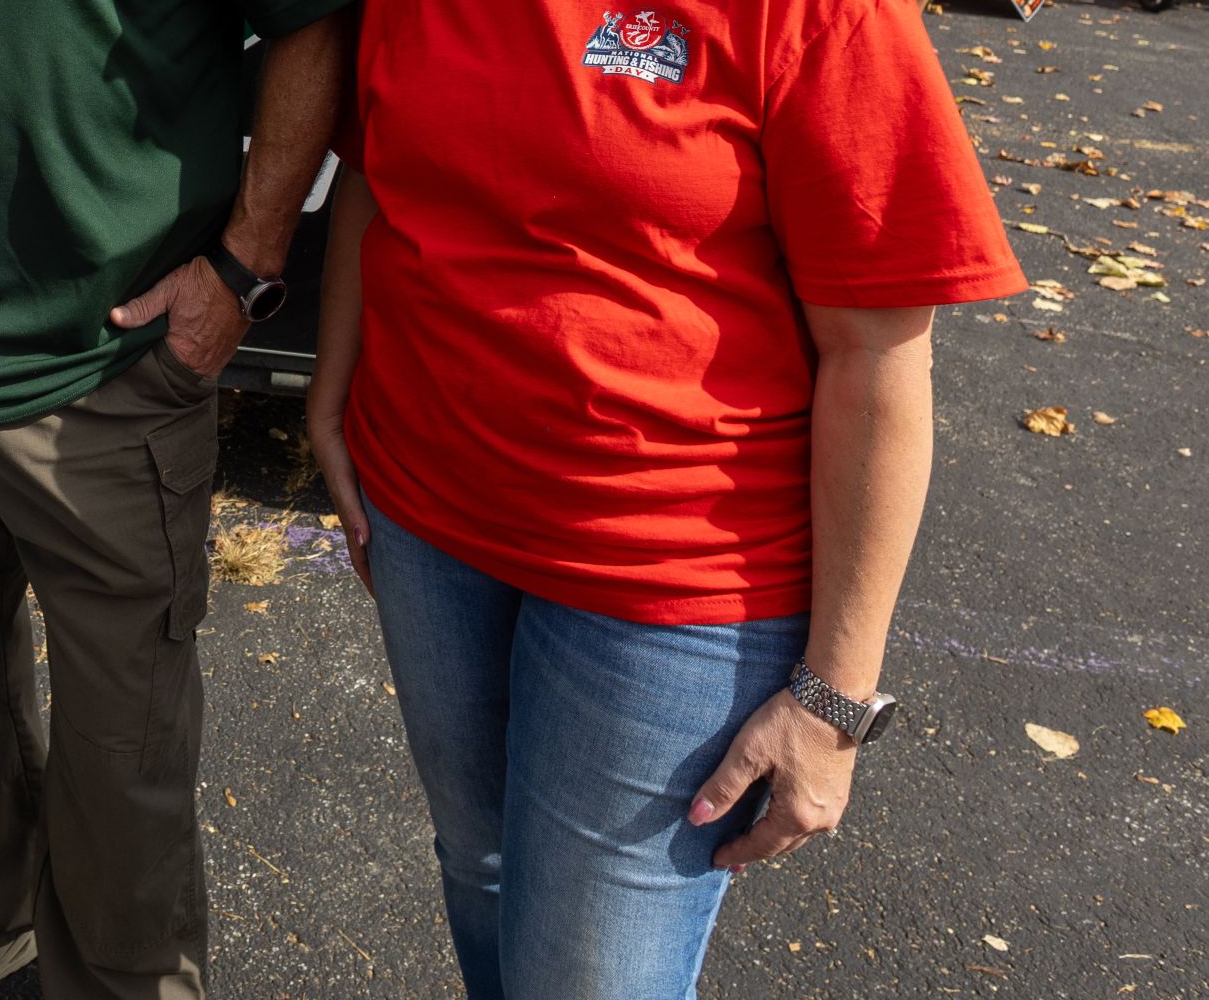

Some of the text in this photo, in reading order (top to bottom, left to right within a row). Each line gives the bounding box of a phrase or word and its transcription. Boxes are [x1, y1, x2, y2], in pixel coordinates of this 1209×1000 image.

[610, 50, 659, 62] NATIONAL
[584, 53, 681, 81] HUNTING & FISHING
[615, 65, 644, 76] DAY
